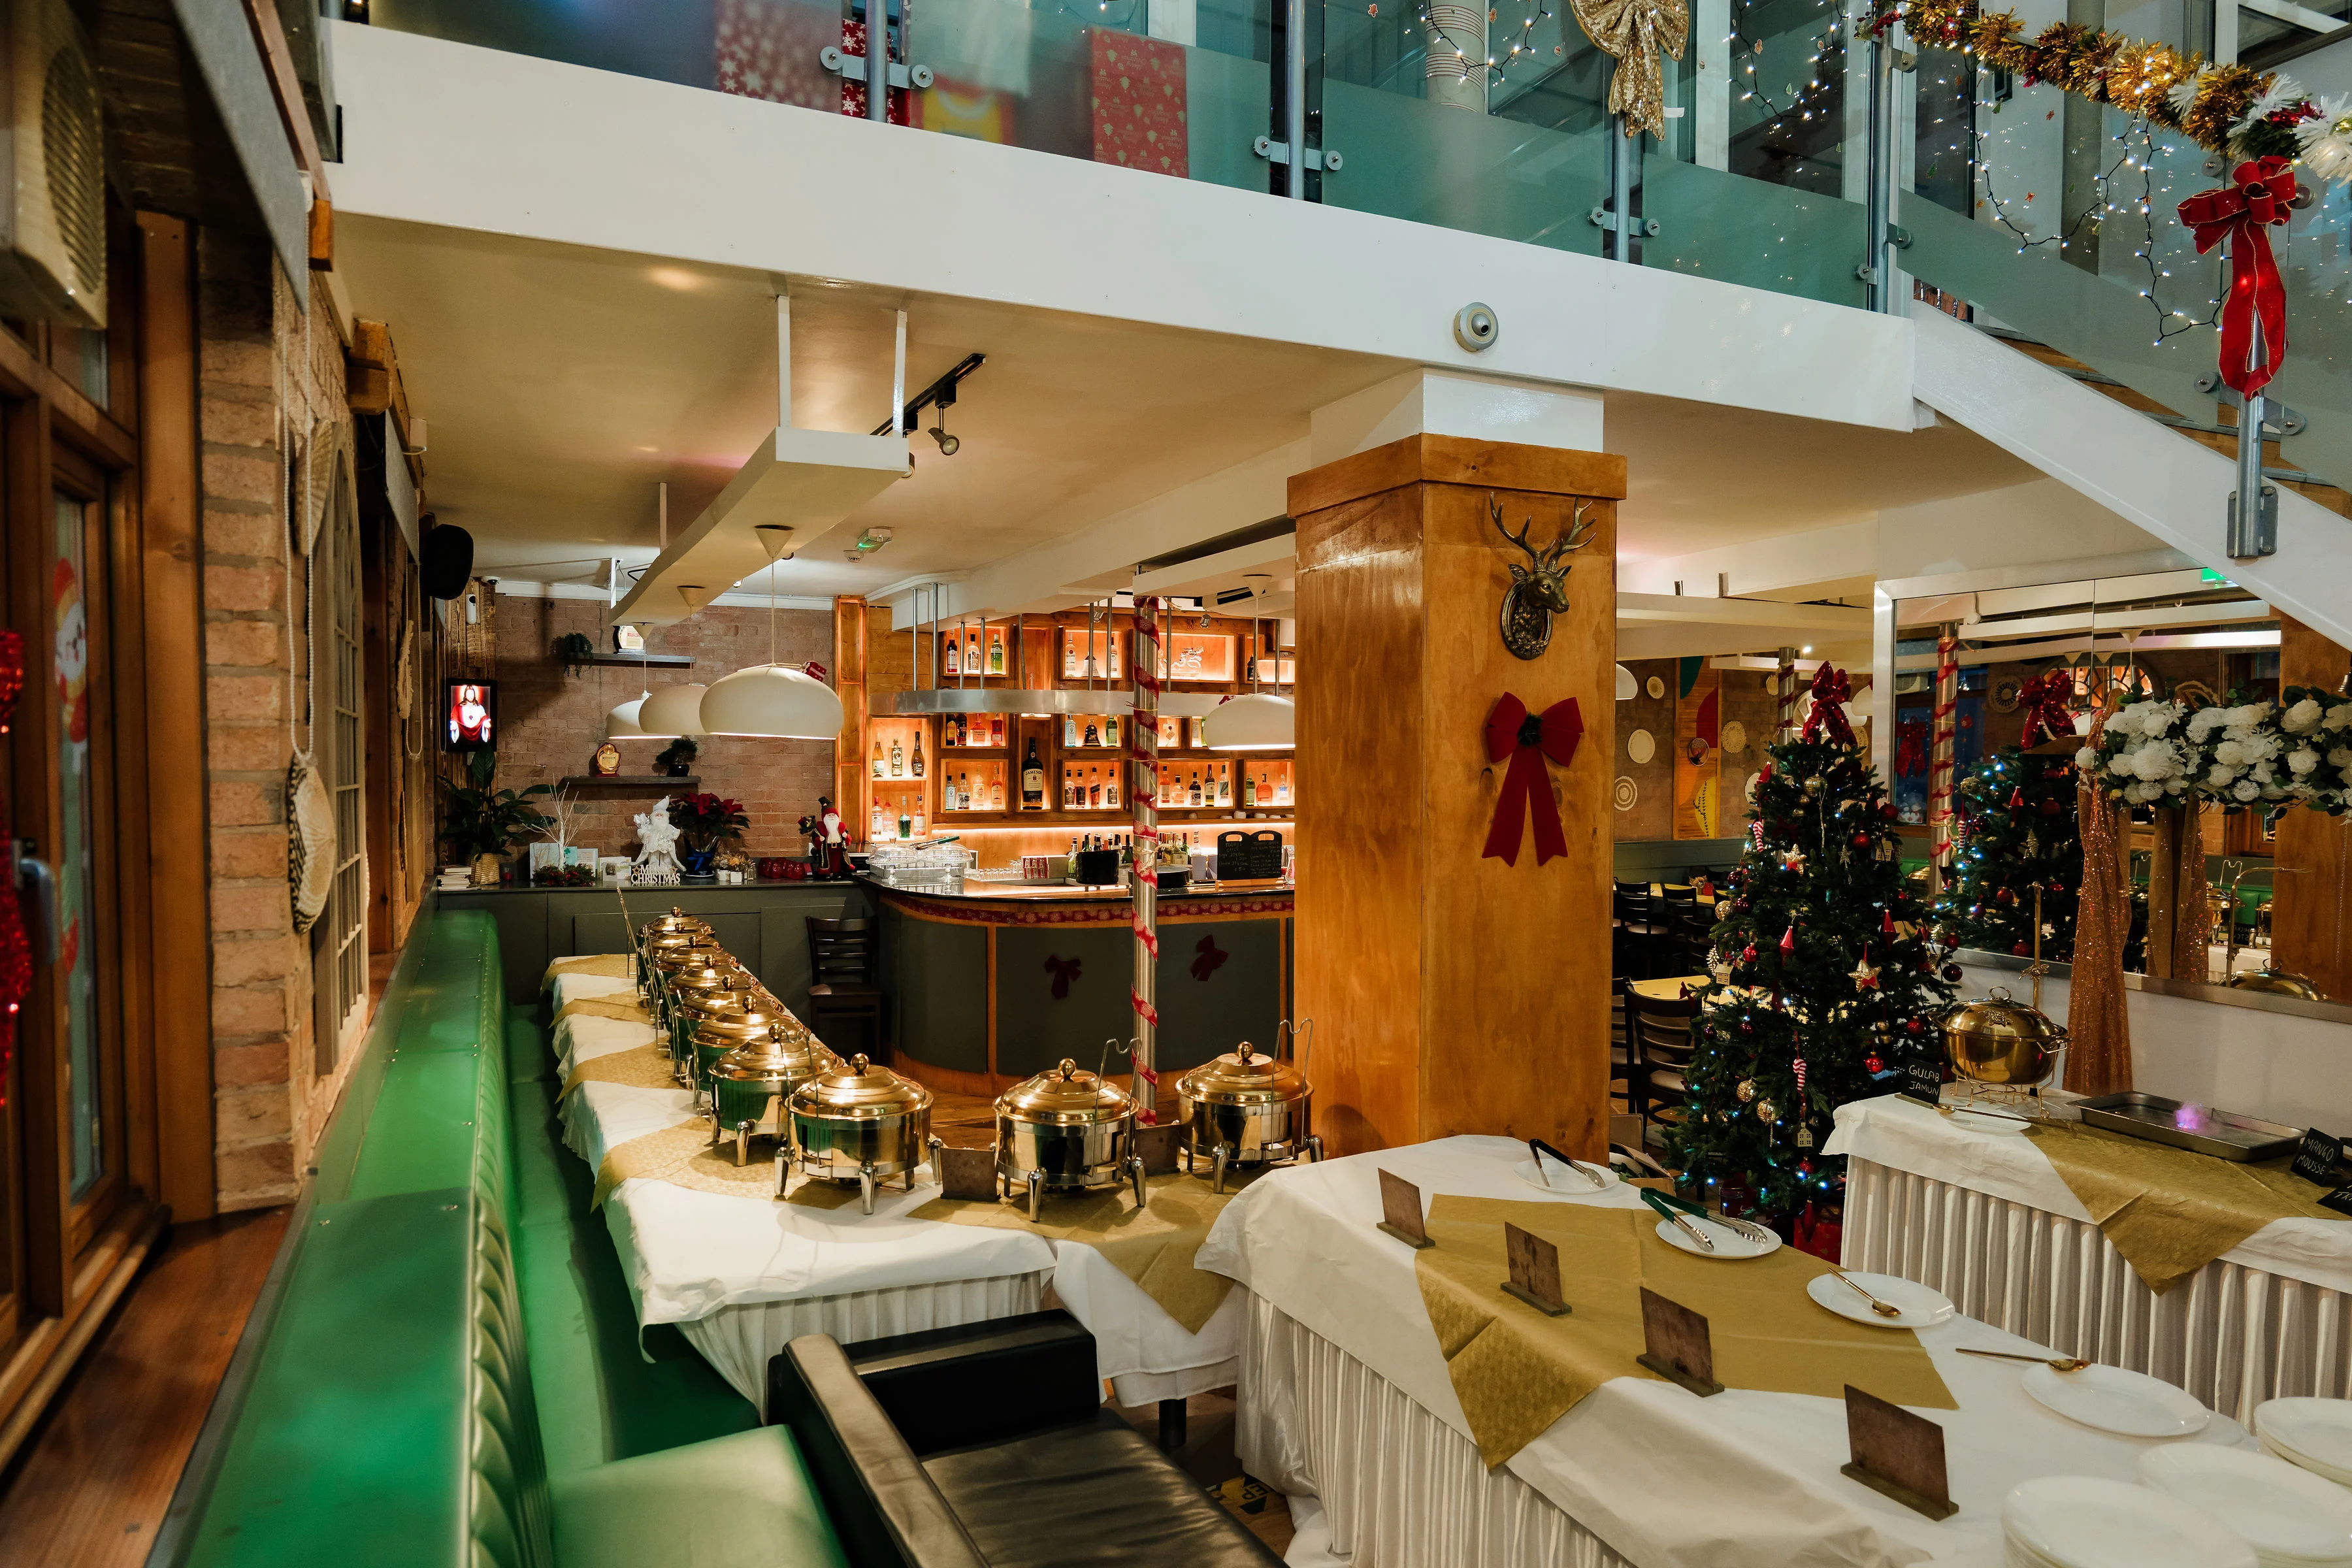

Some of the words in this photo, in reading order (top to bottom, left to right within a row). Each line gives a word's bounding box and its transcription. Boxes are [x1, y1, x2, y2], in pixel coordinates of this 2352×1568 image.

[631, 873, 680, 883] CHRISTMAS
[1909, 1065, 1940, 1082] GULAB
[1909, 1081, 1940, 1096] JAMUN
[2304, 1138, 2334, 1162] MANGO
[2296, 1154, 2327, 1175] MOUSSE
